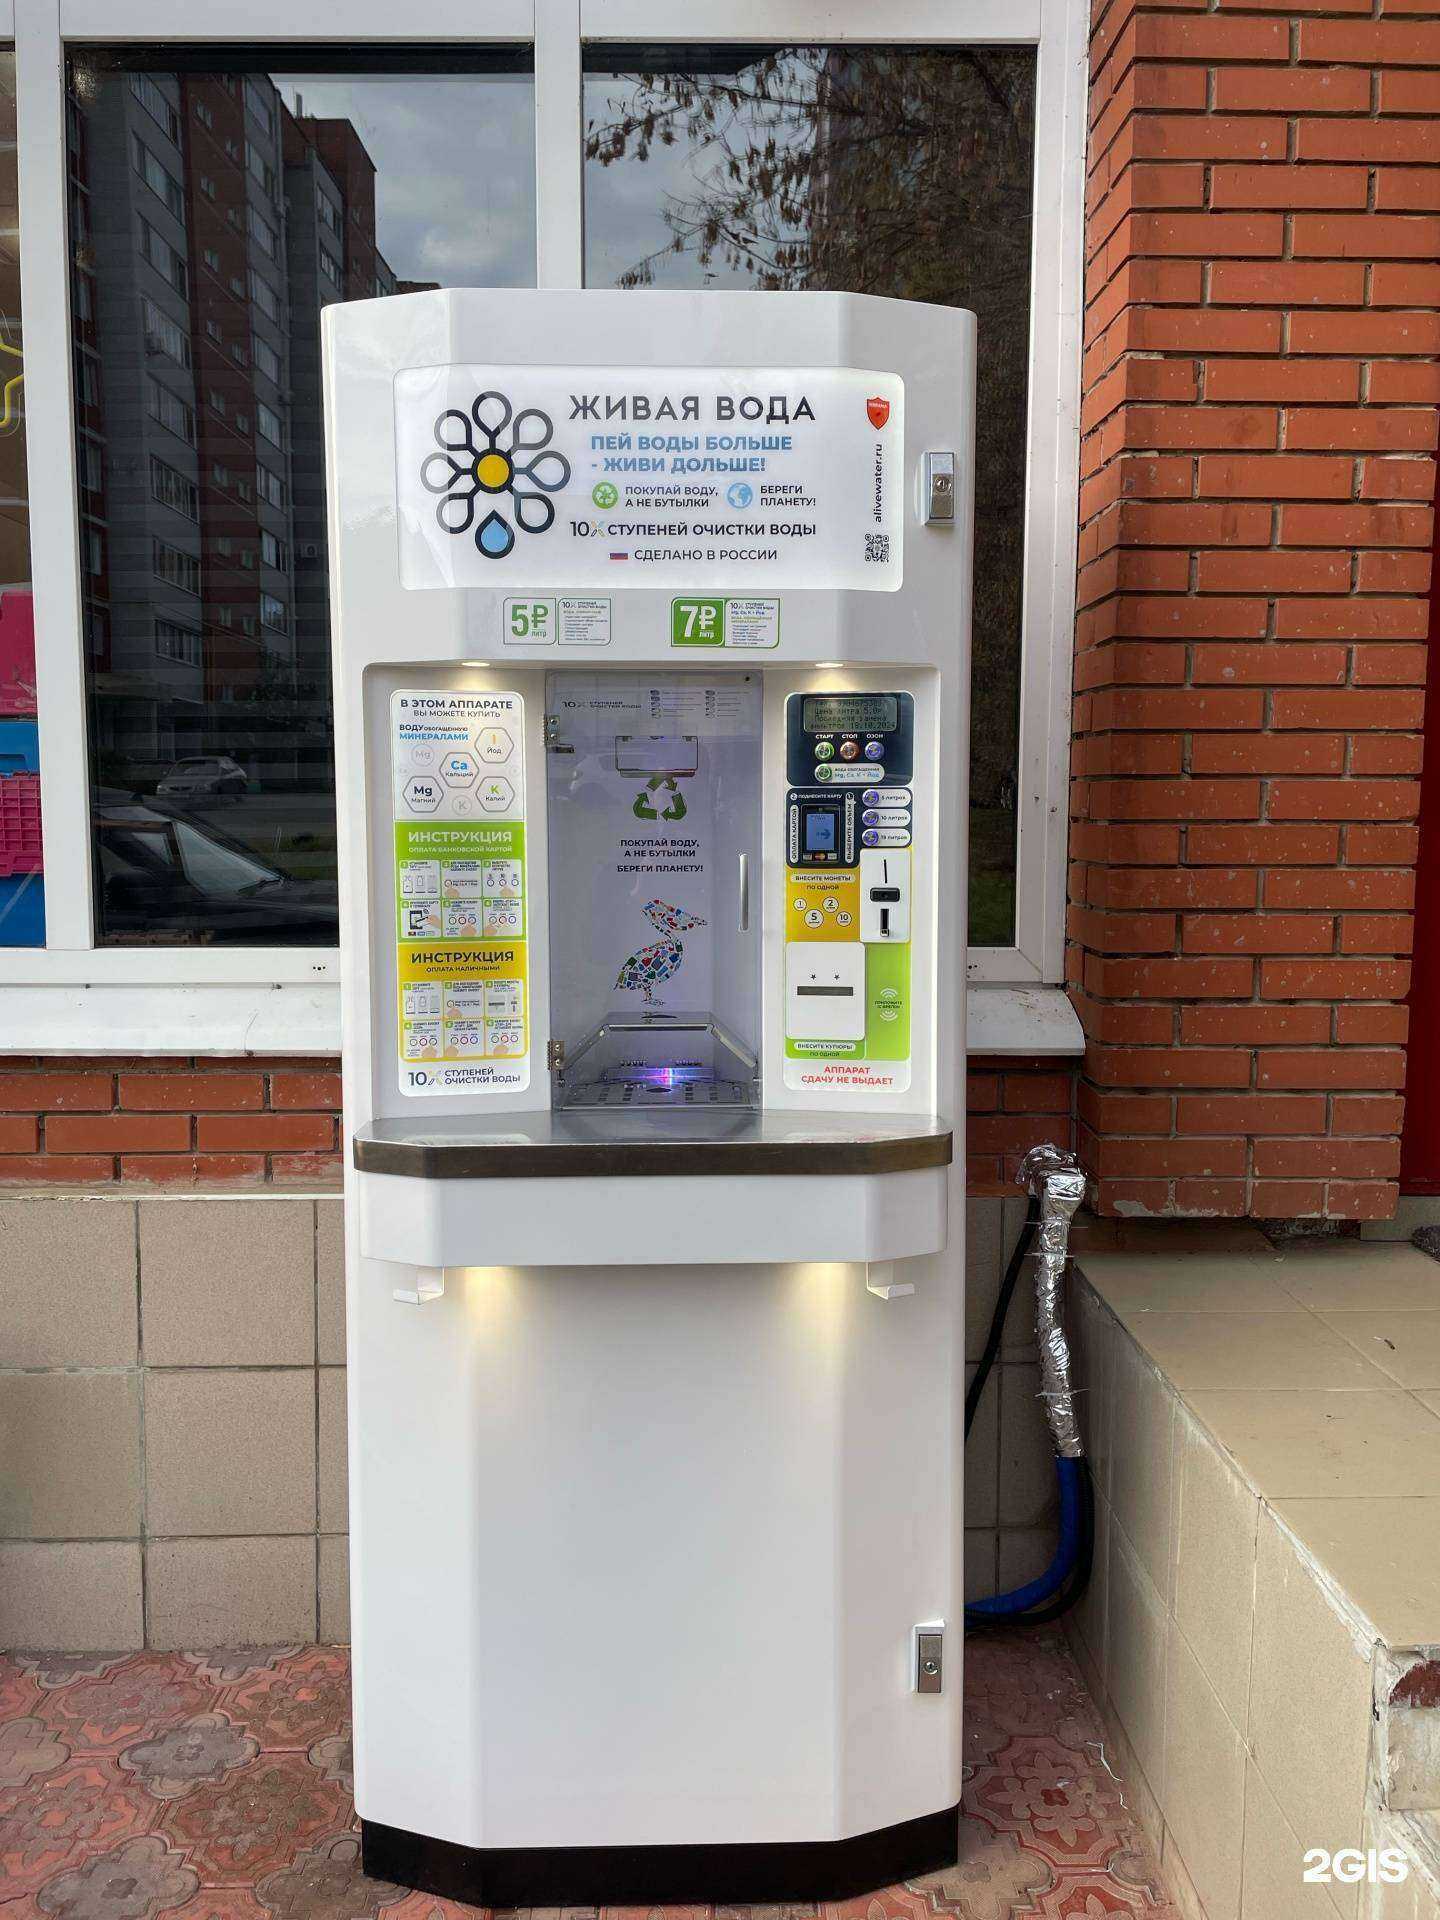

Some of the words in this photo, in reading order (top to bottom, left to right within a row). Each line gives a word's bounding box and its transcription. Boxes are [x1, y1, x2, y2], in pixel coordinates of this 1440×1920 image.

[569, 395, 699, 421] ЖИВАЯ
[716, 395, 816, 424] ВОДА
[591, 432, 631, 450] ПЕЙ
[638, 436, 698, 452] ВОДЫ
[706, 436, 792, 450] БОЛЬШЕ
[604, 458, 665, 472] ЖИВИ
[671, 458, 765, 474] ДОЛЬШЕ!
[873, 444, 882, 522] alivewater.ru
[625, 484, 681, 495] ПОКУПАЙ
[685, 486, 718, 497] ВОДУ,
[761, 486, 803, 494] БЕРЕГИ
[625, 499, 633, 507] А
[636, 499, 651, 507] НЕ
[654, 499, 709, 508] БУТЫЛКИ
[761, 498, 816, 506] ПЛАНЕТУ!
[608, 521, 688, 536] СТУПЕНЕЙ
[693, 524, 765, 536] ОЧИСТКИ
[770, 524, 816, 537] ВОДЫ
[634, 550, 703, 561] СДЕЛАНО
[707, 550, 715, 560] В
[720, 550, 777, 560] РОССИИ
[412, 700, 445, 708] ЭТОМ
[449, 700, 513, 709] АППАРАТЕ
[415, 750, 430, 759] Mg
[451, 761, 468, 770] Ca
[414, 786, 433, 796] Mg
[408, 832, 512, 844] ИНСТРУКЦИЯ
[620, 838, 668, 847] ПОКУПАЙ
[671, 840, 700, 848] ВОДУ,
[412, 951, 514, 964] ИНСТРУКЦИЯ
[445, 1067, 494, 1077] СТУПЕНЕЙ
[824, 1066, 871, 1074] АППАРАТ
[445, 1076, 490, 1085] ОЧИСТКИ
[852, 1077, 893, 1085] ВЫДАЕТ
